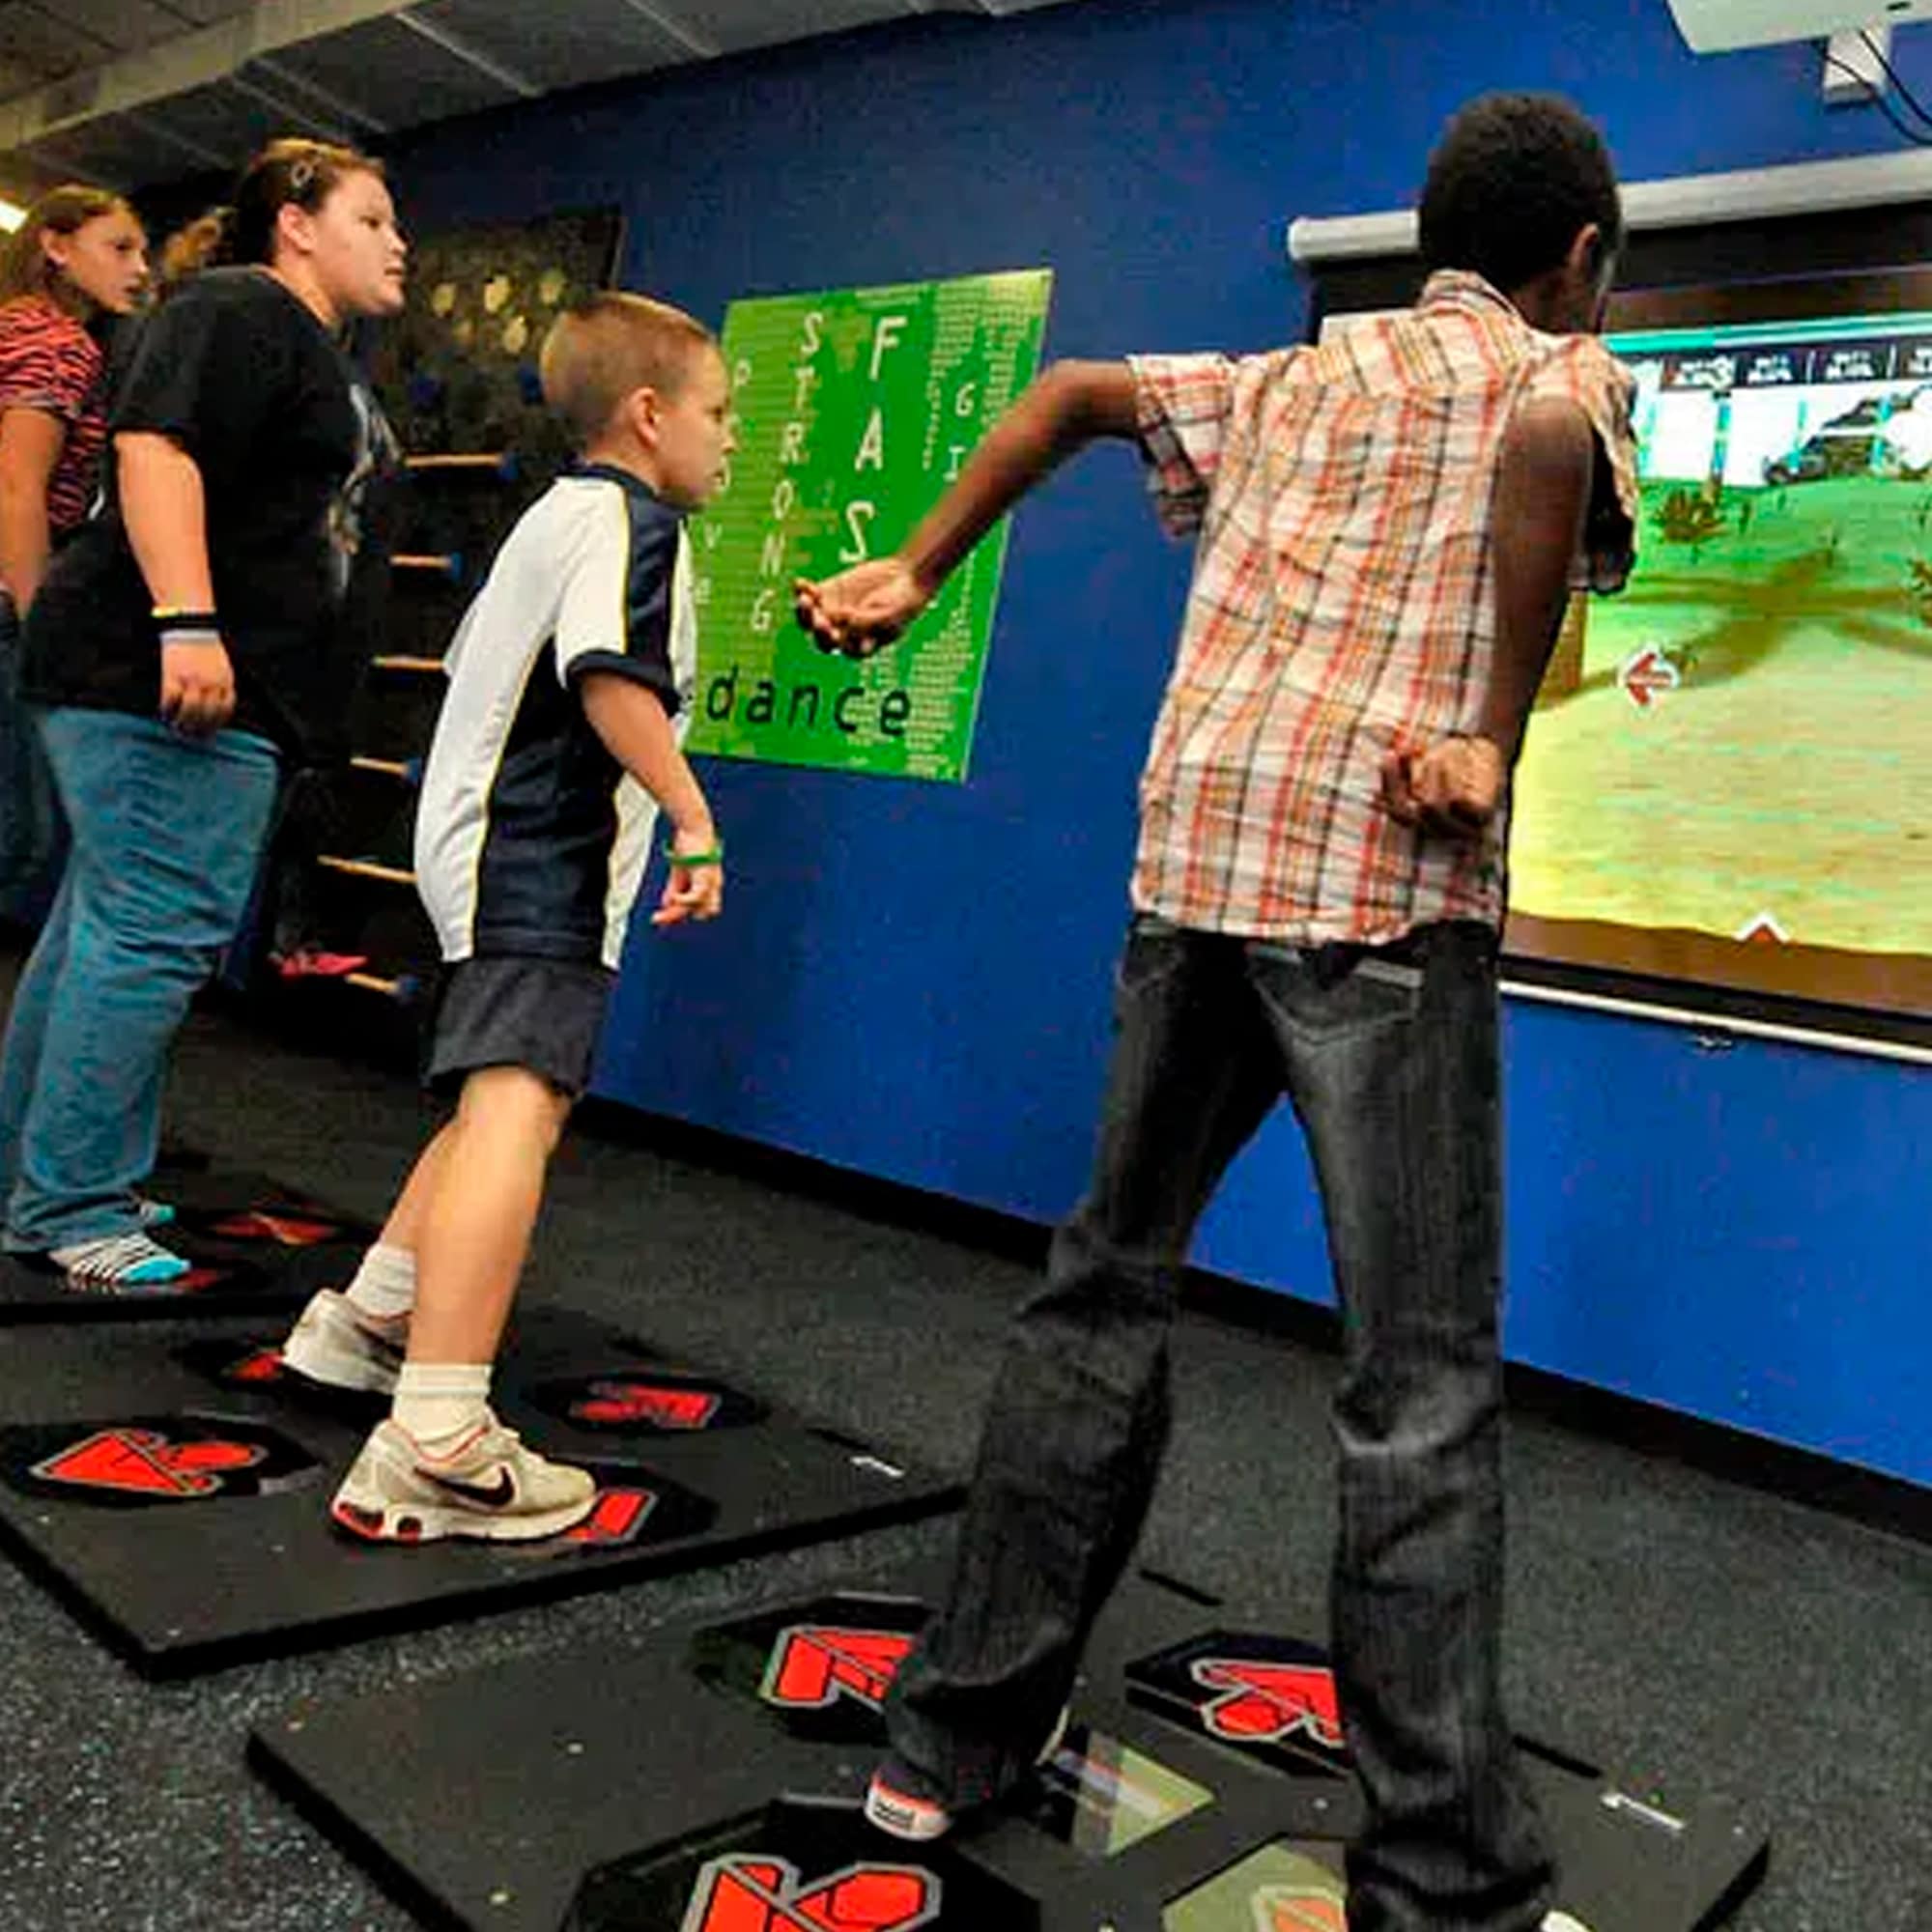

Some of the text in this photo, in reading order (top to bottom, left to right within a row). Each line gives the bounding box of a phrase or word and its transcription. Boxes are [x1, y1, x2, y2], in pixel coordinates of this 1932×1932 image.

[751, 311, 823, 631] STRONG
[838, 314, 909, 564] FAS
[706, 664, 910, 737] dance
